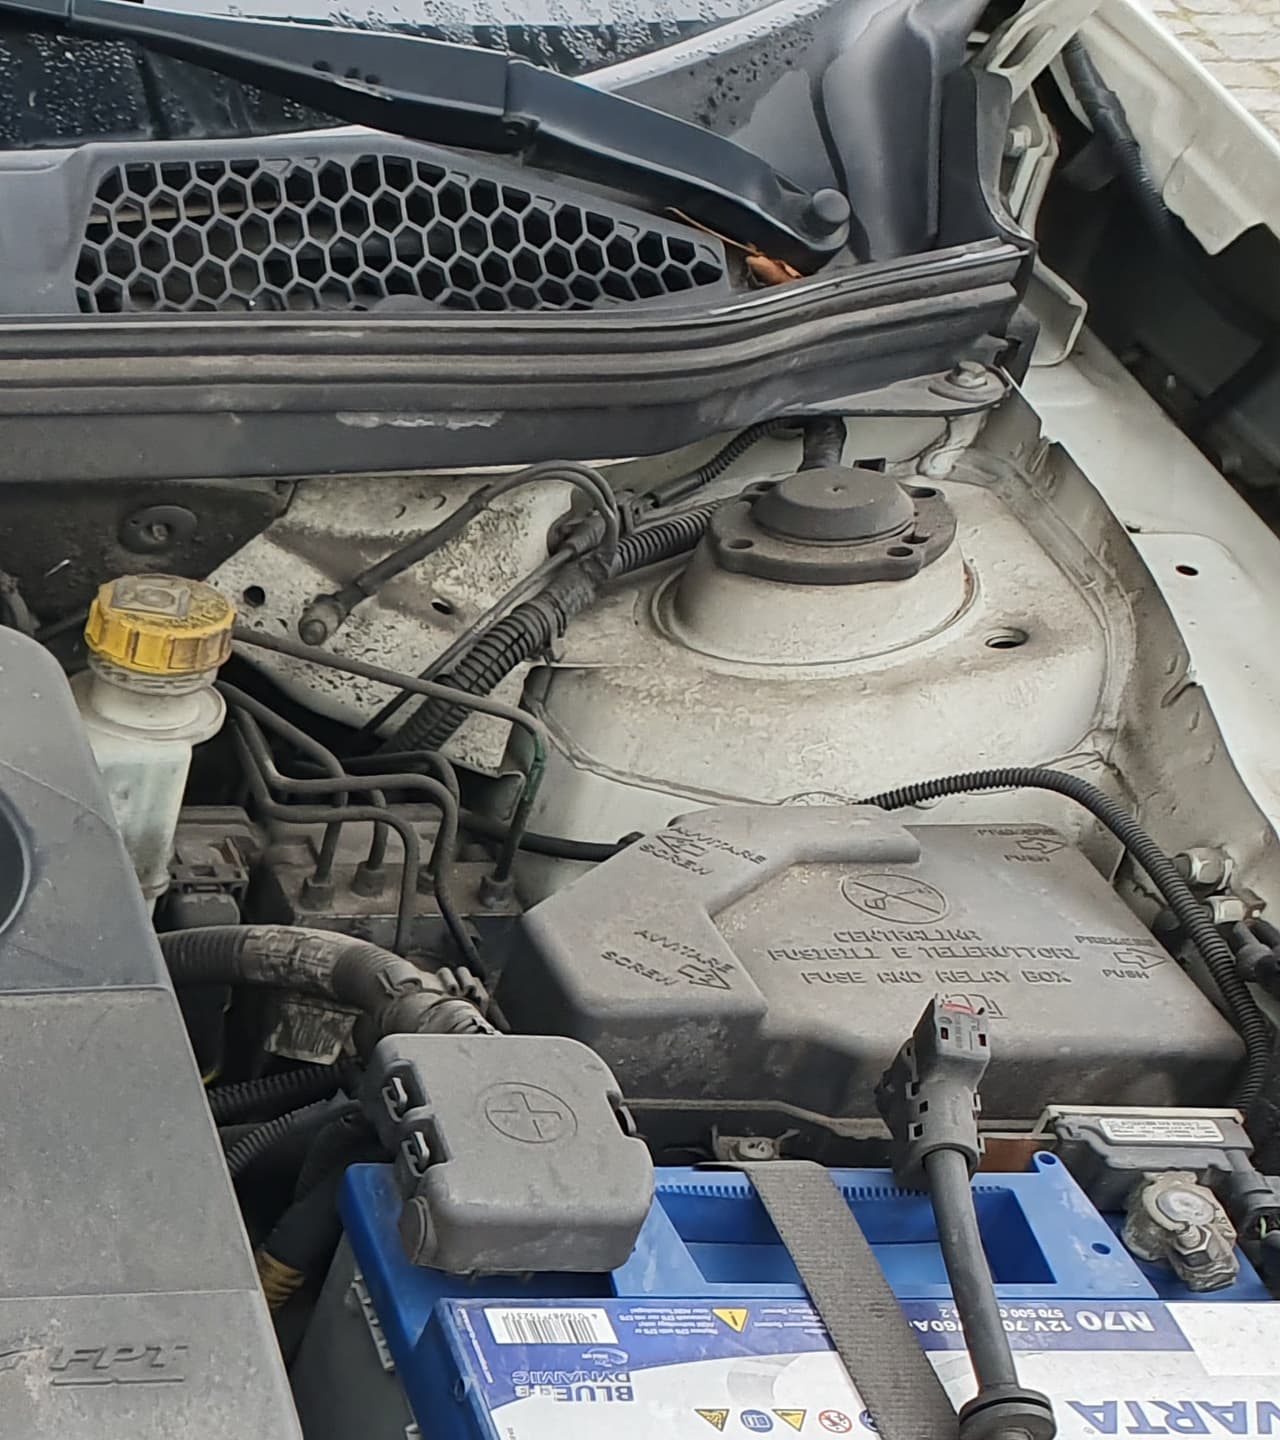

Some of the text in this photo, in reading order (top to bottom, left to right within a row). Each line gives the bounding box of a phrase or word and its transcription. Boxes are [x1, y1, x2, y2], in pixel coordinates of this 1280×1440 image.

[639, 843, 713, 876] SCREW
[1003, 853, 1051, 863] PUSH
[832, 929, 983, 943] CENTRALINA
[767, 947, 880, 961] FUSIBILI
[889, 946, 912, 959] E
[601, 950, 679, 986] SCREW
[1099, 968, 1151, 980] PUSH
[801, 970, 1073, 985] FUSE AND RELAY BOX
[1032, 1319, 1073, 1333] 12V
[1074, 1310, 1156, 1334] N70
[48, 1345, 189, 1372] FPT
[511, 1370, 633, 1386] DYNAMIC
[553, 1385, 635, 1403] BLUE
